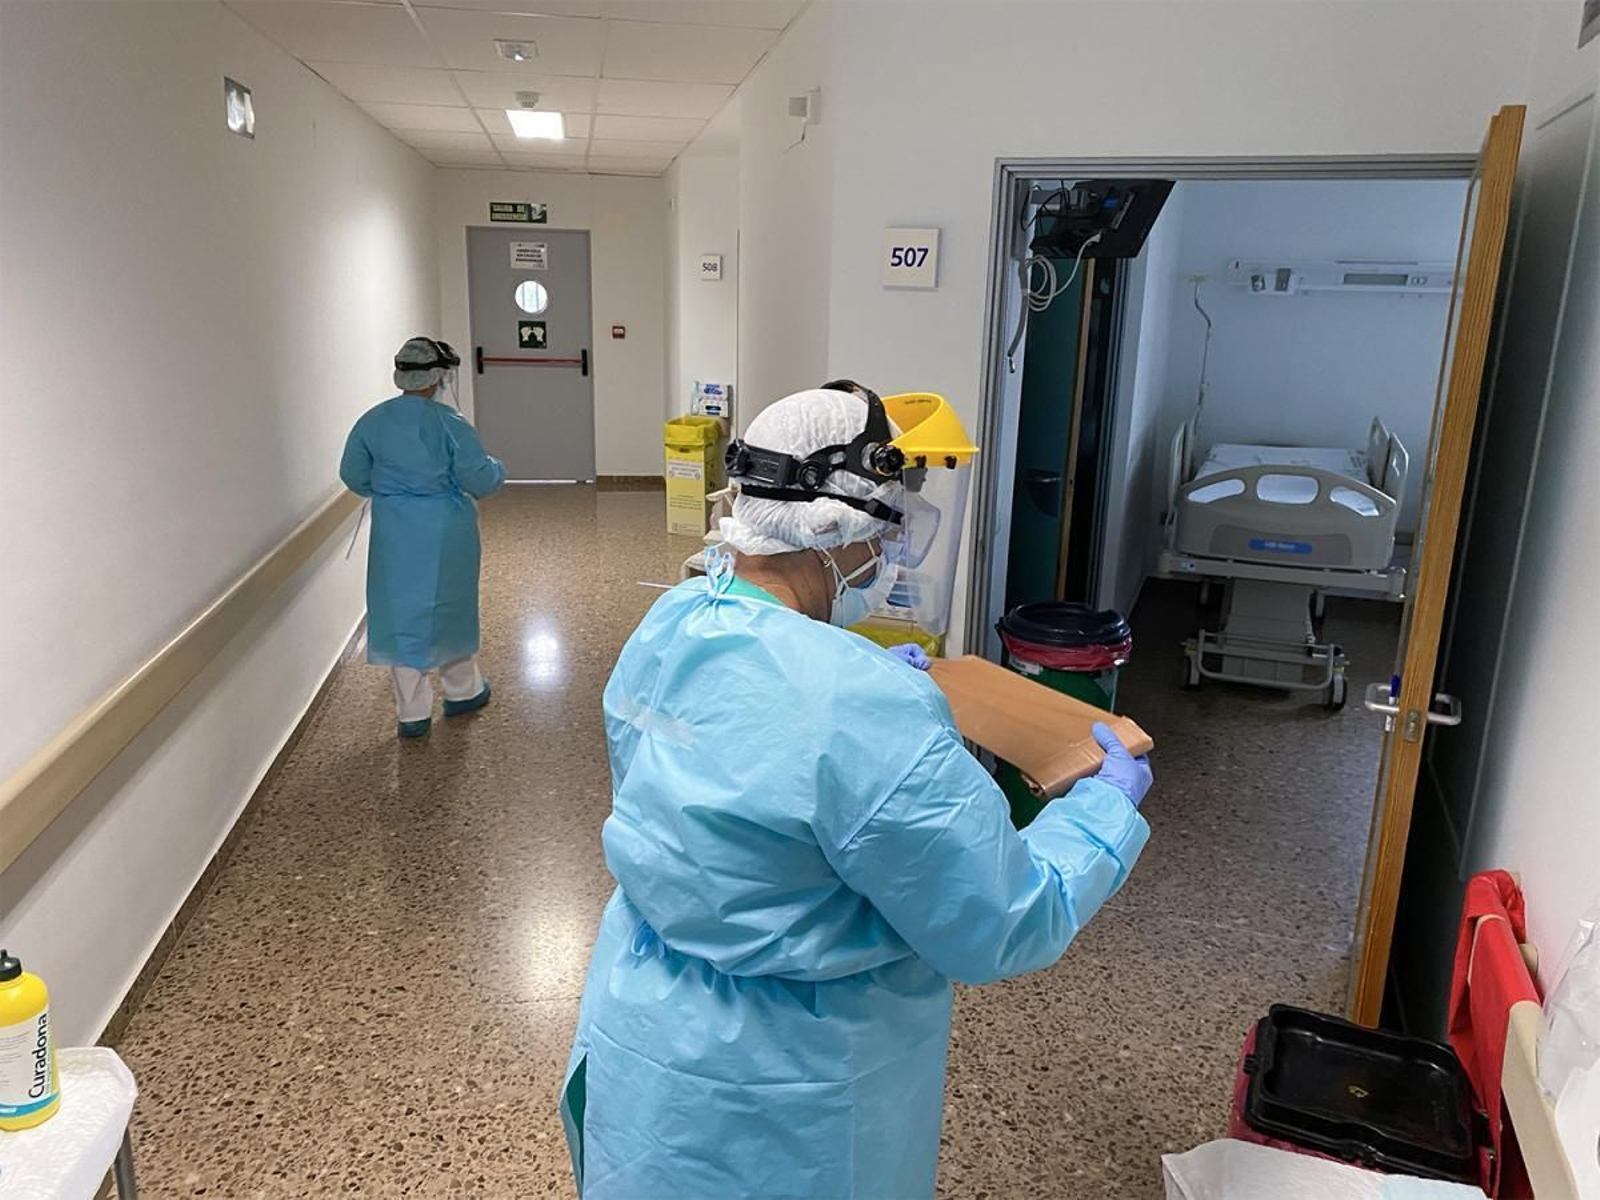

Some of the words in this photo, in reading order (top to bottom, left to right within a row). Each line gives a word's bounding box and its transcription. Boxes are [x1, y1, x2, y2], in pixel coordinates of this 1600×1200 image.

[702, 262, 718, 272] 508
[890, 247, 929, 268] 507
[28, 1013, 48, 1098] Curadona
